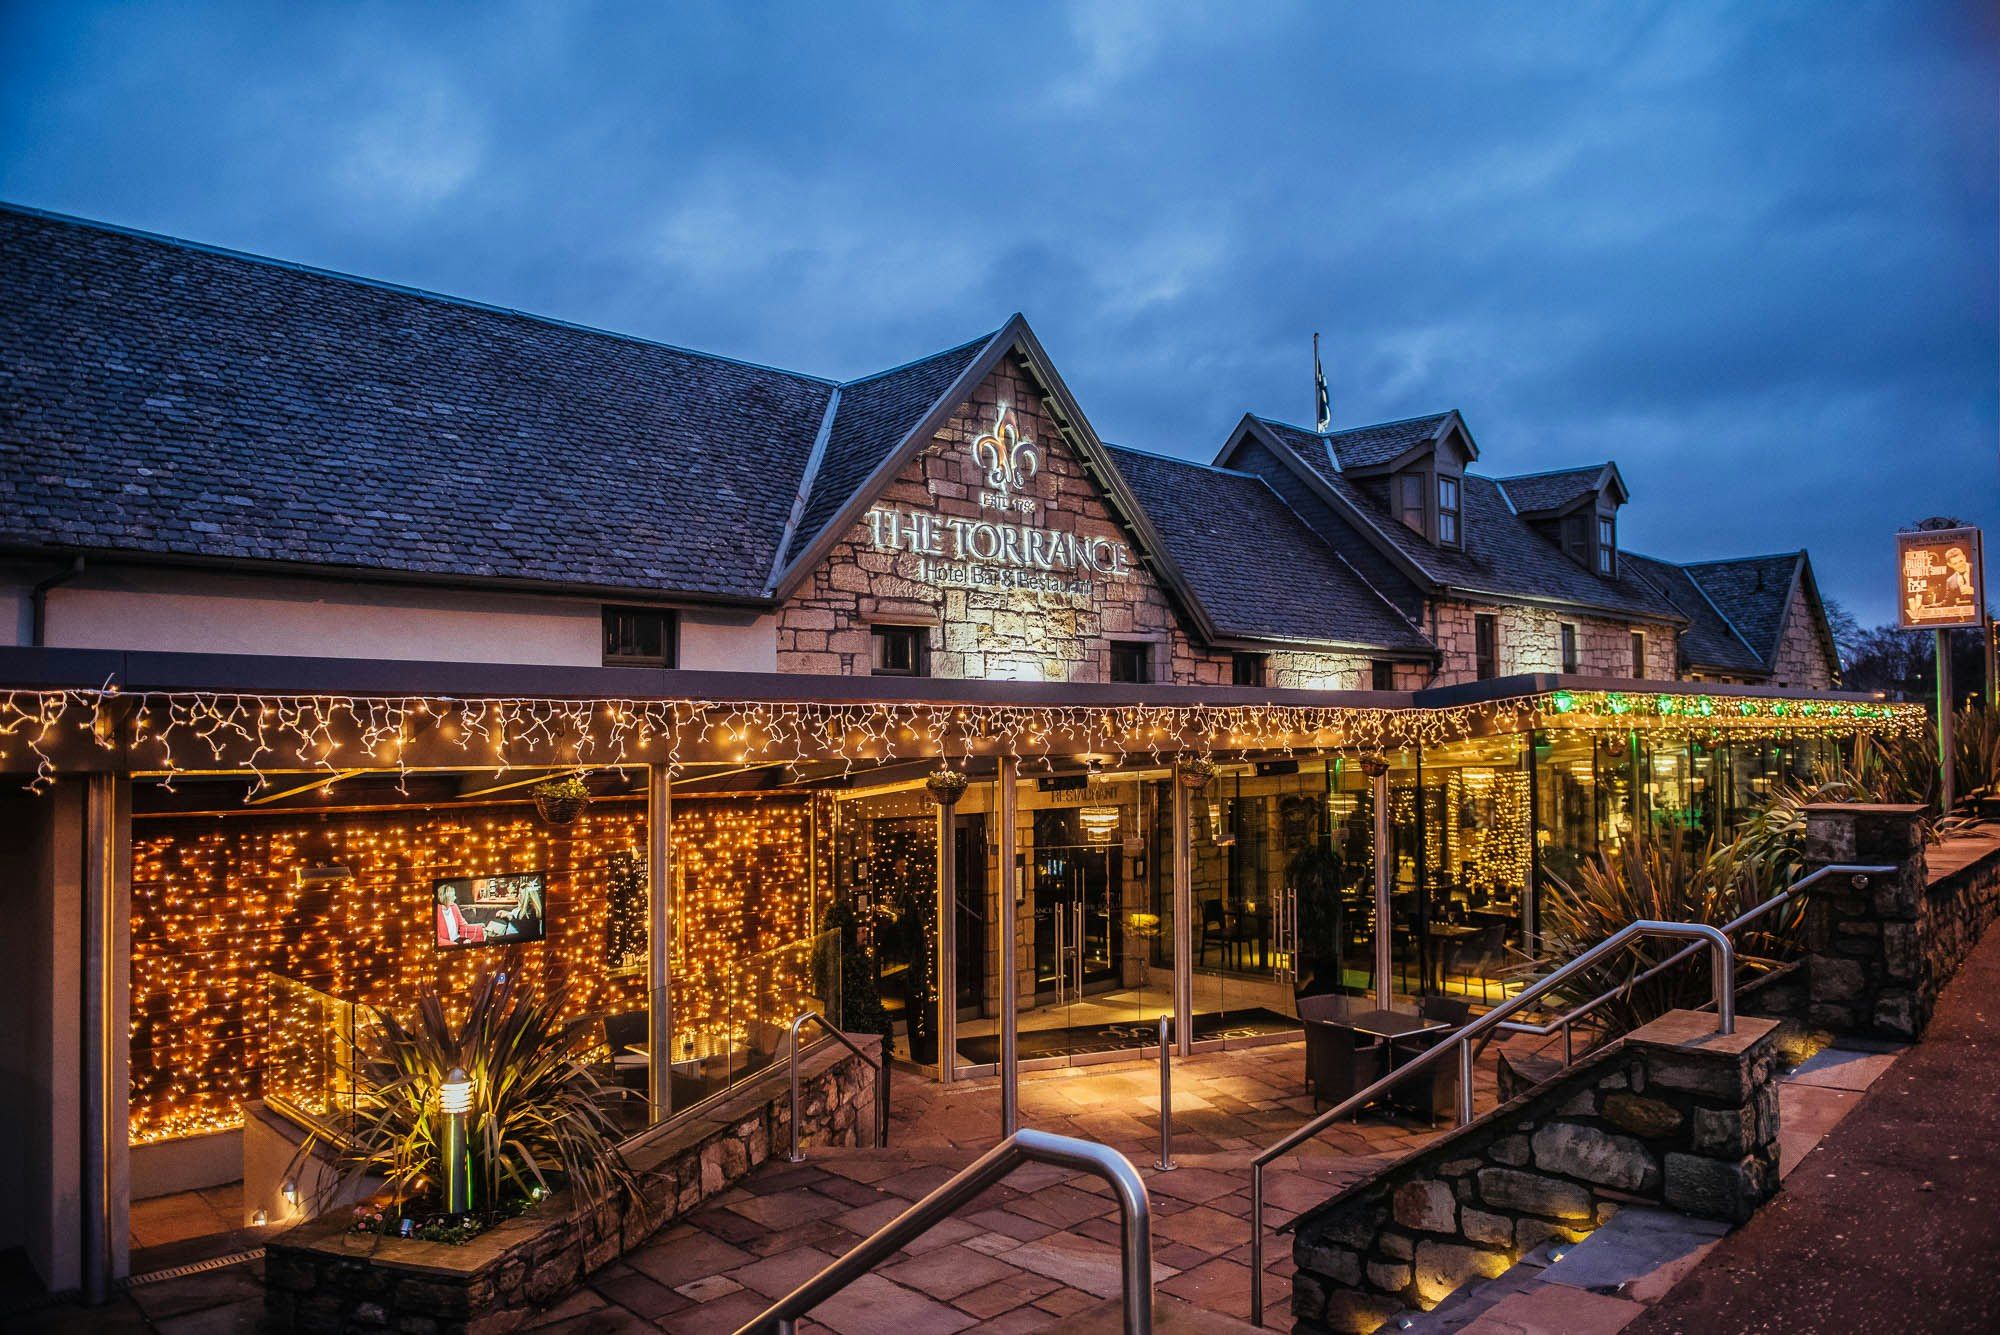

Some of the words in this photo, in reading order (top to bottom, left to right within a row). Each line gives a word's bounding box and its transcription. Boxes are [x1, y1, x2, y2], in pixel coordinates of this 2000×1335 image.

[866, 507, 944, 554] THE
[947, 518, 1130, 575] TORRANCE
[922, 562, 967, 583] Hotel
[970, 565, 998, 586] Bar
[1001, 570, 1014, 588] &
